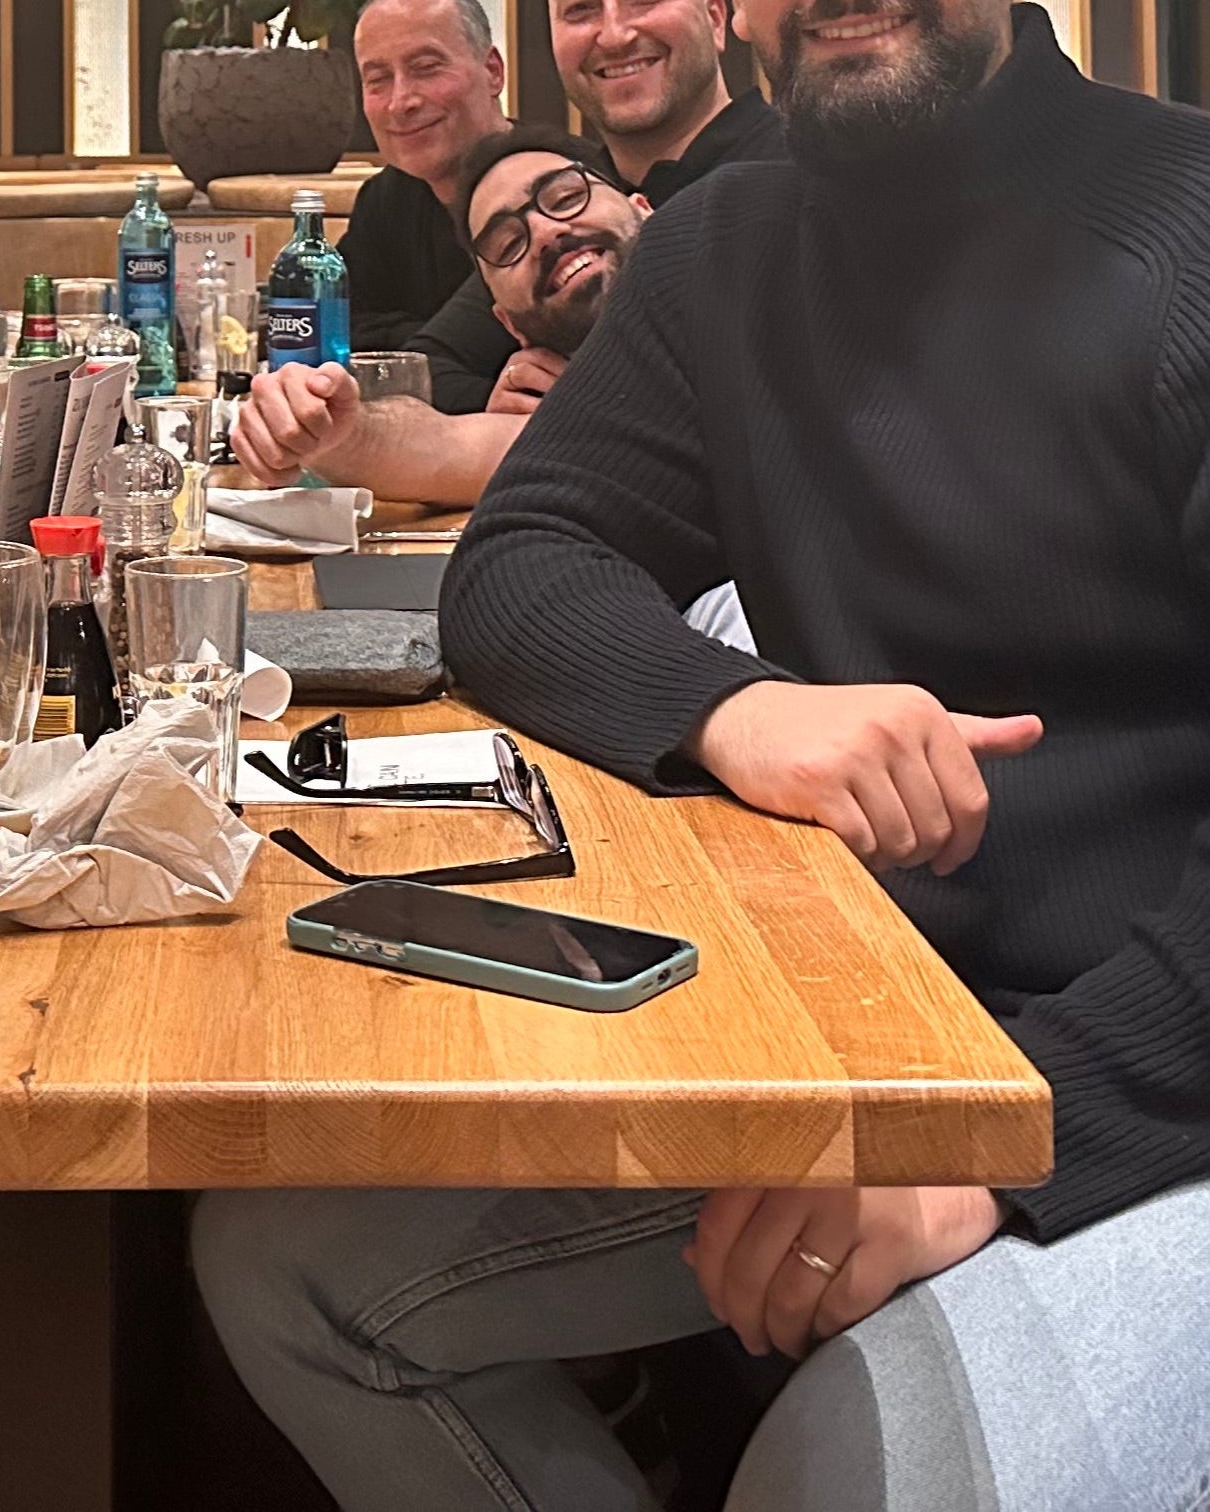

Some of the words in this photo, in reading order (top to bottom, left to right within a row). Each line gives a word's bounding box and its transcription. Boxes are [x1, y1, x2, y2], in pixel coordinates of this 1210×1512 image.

[175, 232, 212, 244] RESH
[217, 232, 236, 244] UP
[126, 259, 167, 276] SELTERS
